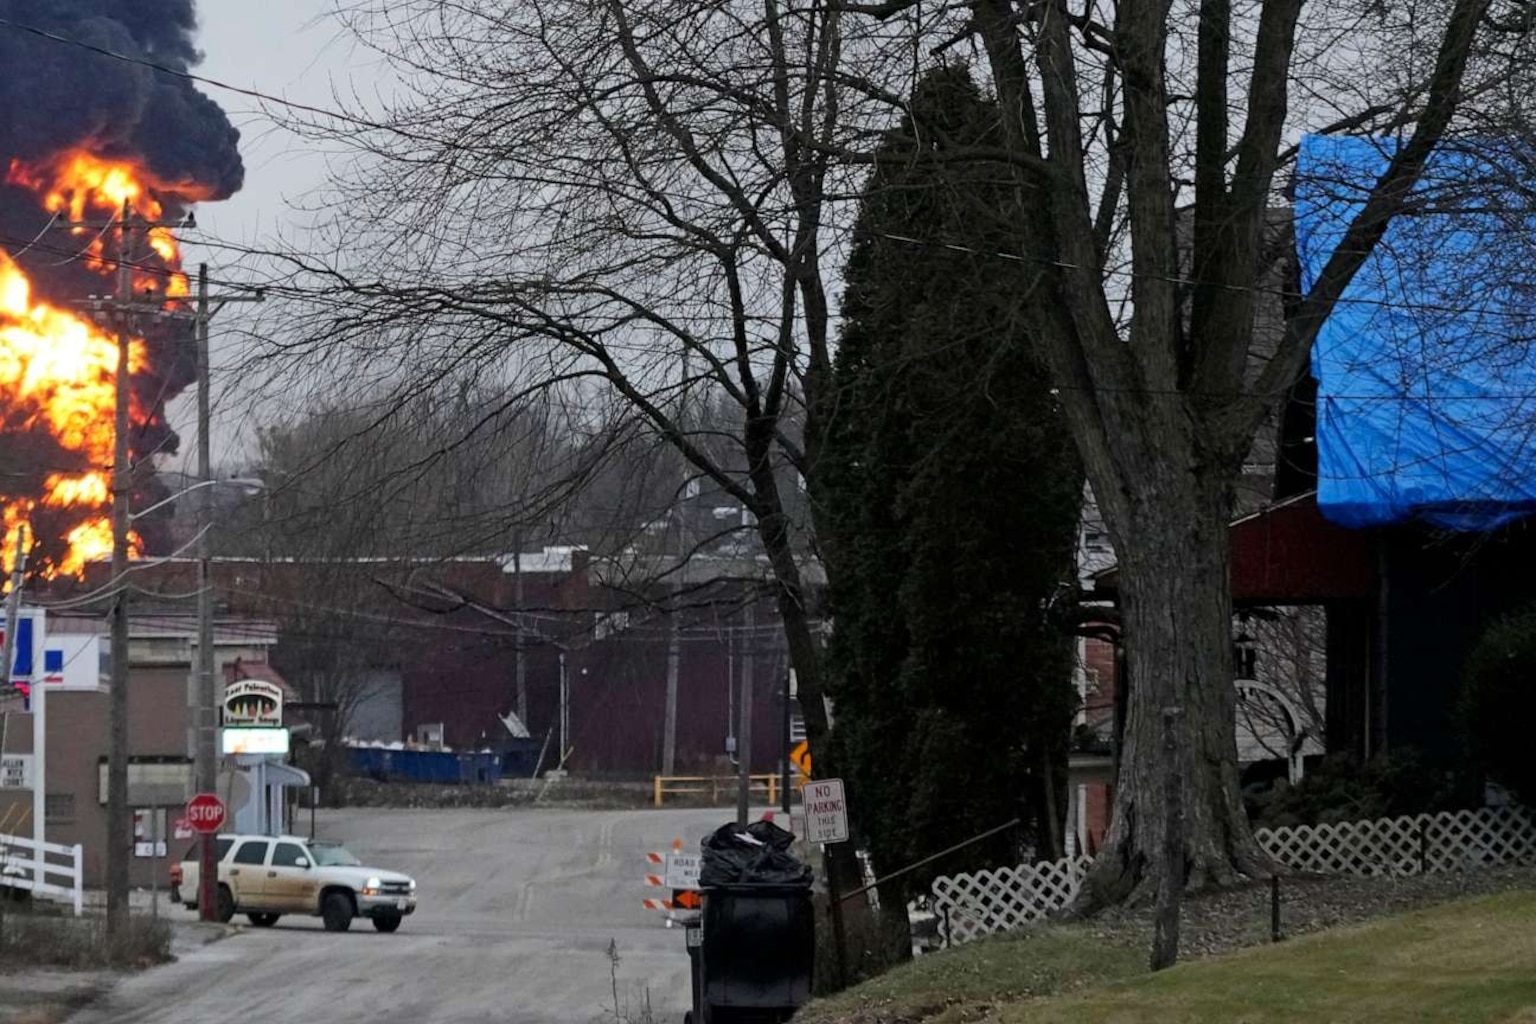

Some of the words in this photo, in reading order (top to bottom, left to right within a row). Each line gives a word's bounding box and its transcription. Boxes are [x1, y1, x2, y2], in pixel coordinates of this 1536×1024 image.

[225, 686, 241, 697] East
[815, 786, 831, 797] NO
[190, 805, 223, 821] STOP
[807, 800, 842, 815] PARKING
[818, 816, 835, 825] THIS
[818, 828, 836, 838] SIDE
[674, 858, 695, 867] ROAD
